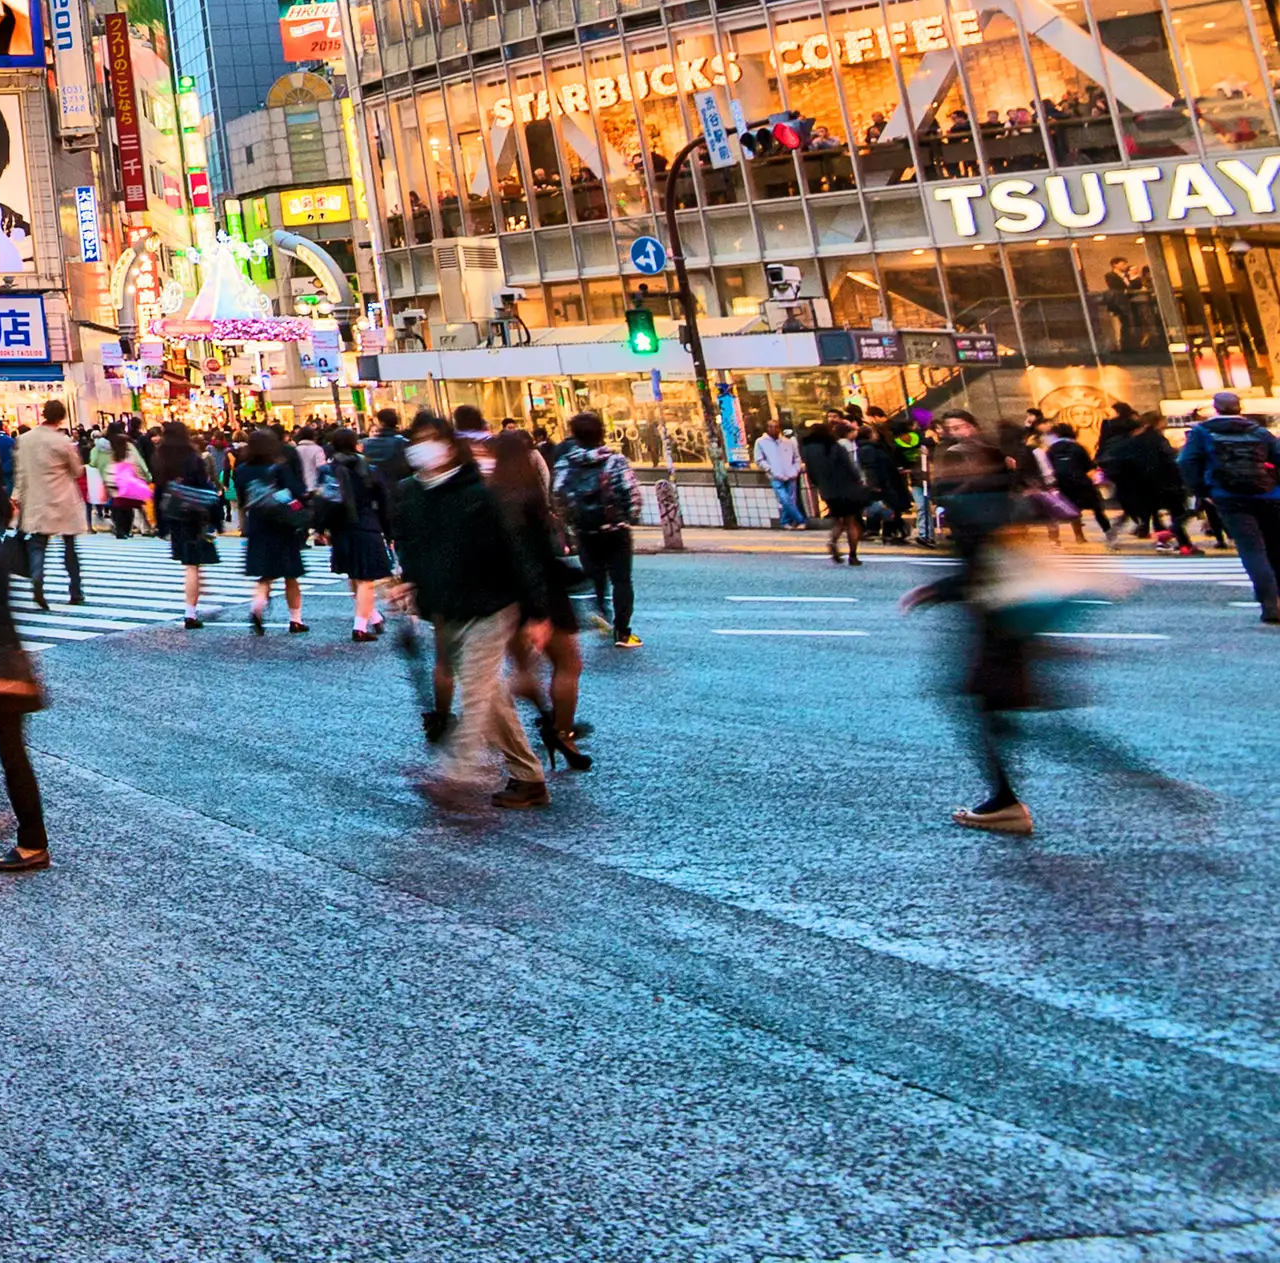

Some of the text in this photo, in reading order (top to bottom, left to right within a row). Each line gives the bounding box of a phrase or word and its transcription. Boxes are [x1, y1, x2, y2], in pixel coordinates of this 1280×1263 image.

[311, 40, 341, 52] 2015
[493, 10, 984, 129] STARBUCKS COFFEE
[111, 19, 146, 202] クスリのことなら 三千里
[934, 154, 1280, 237] TSUTAY
